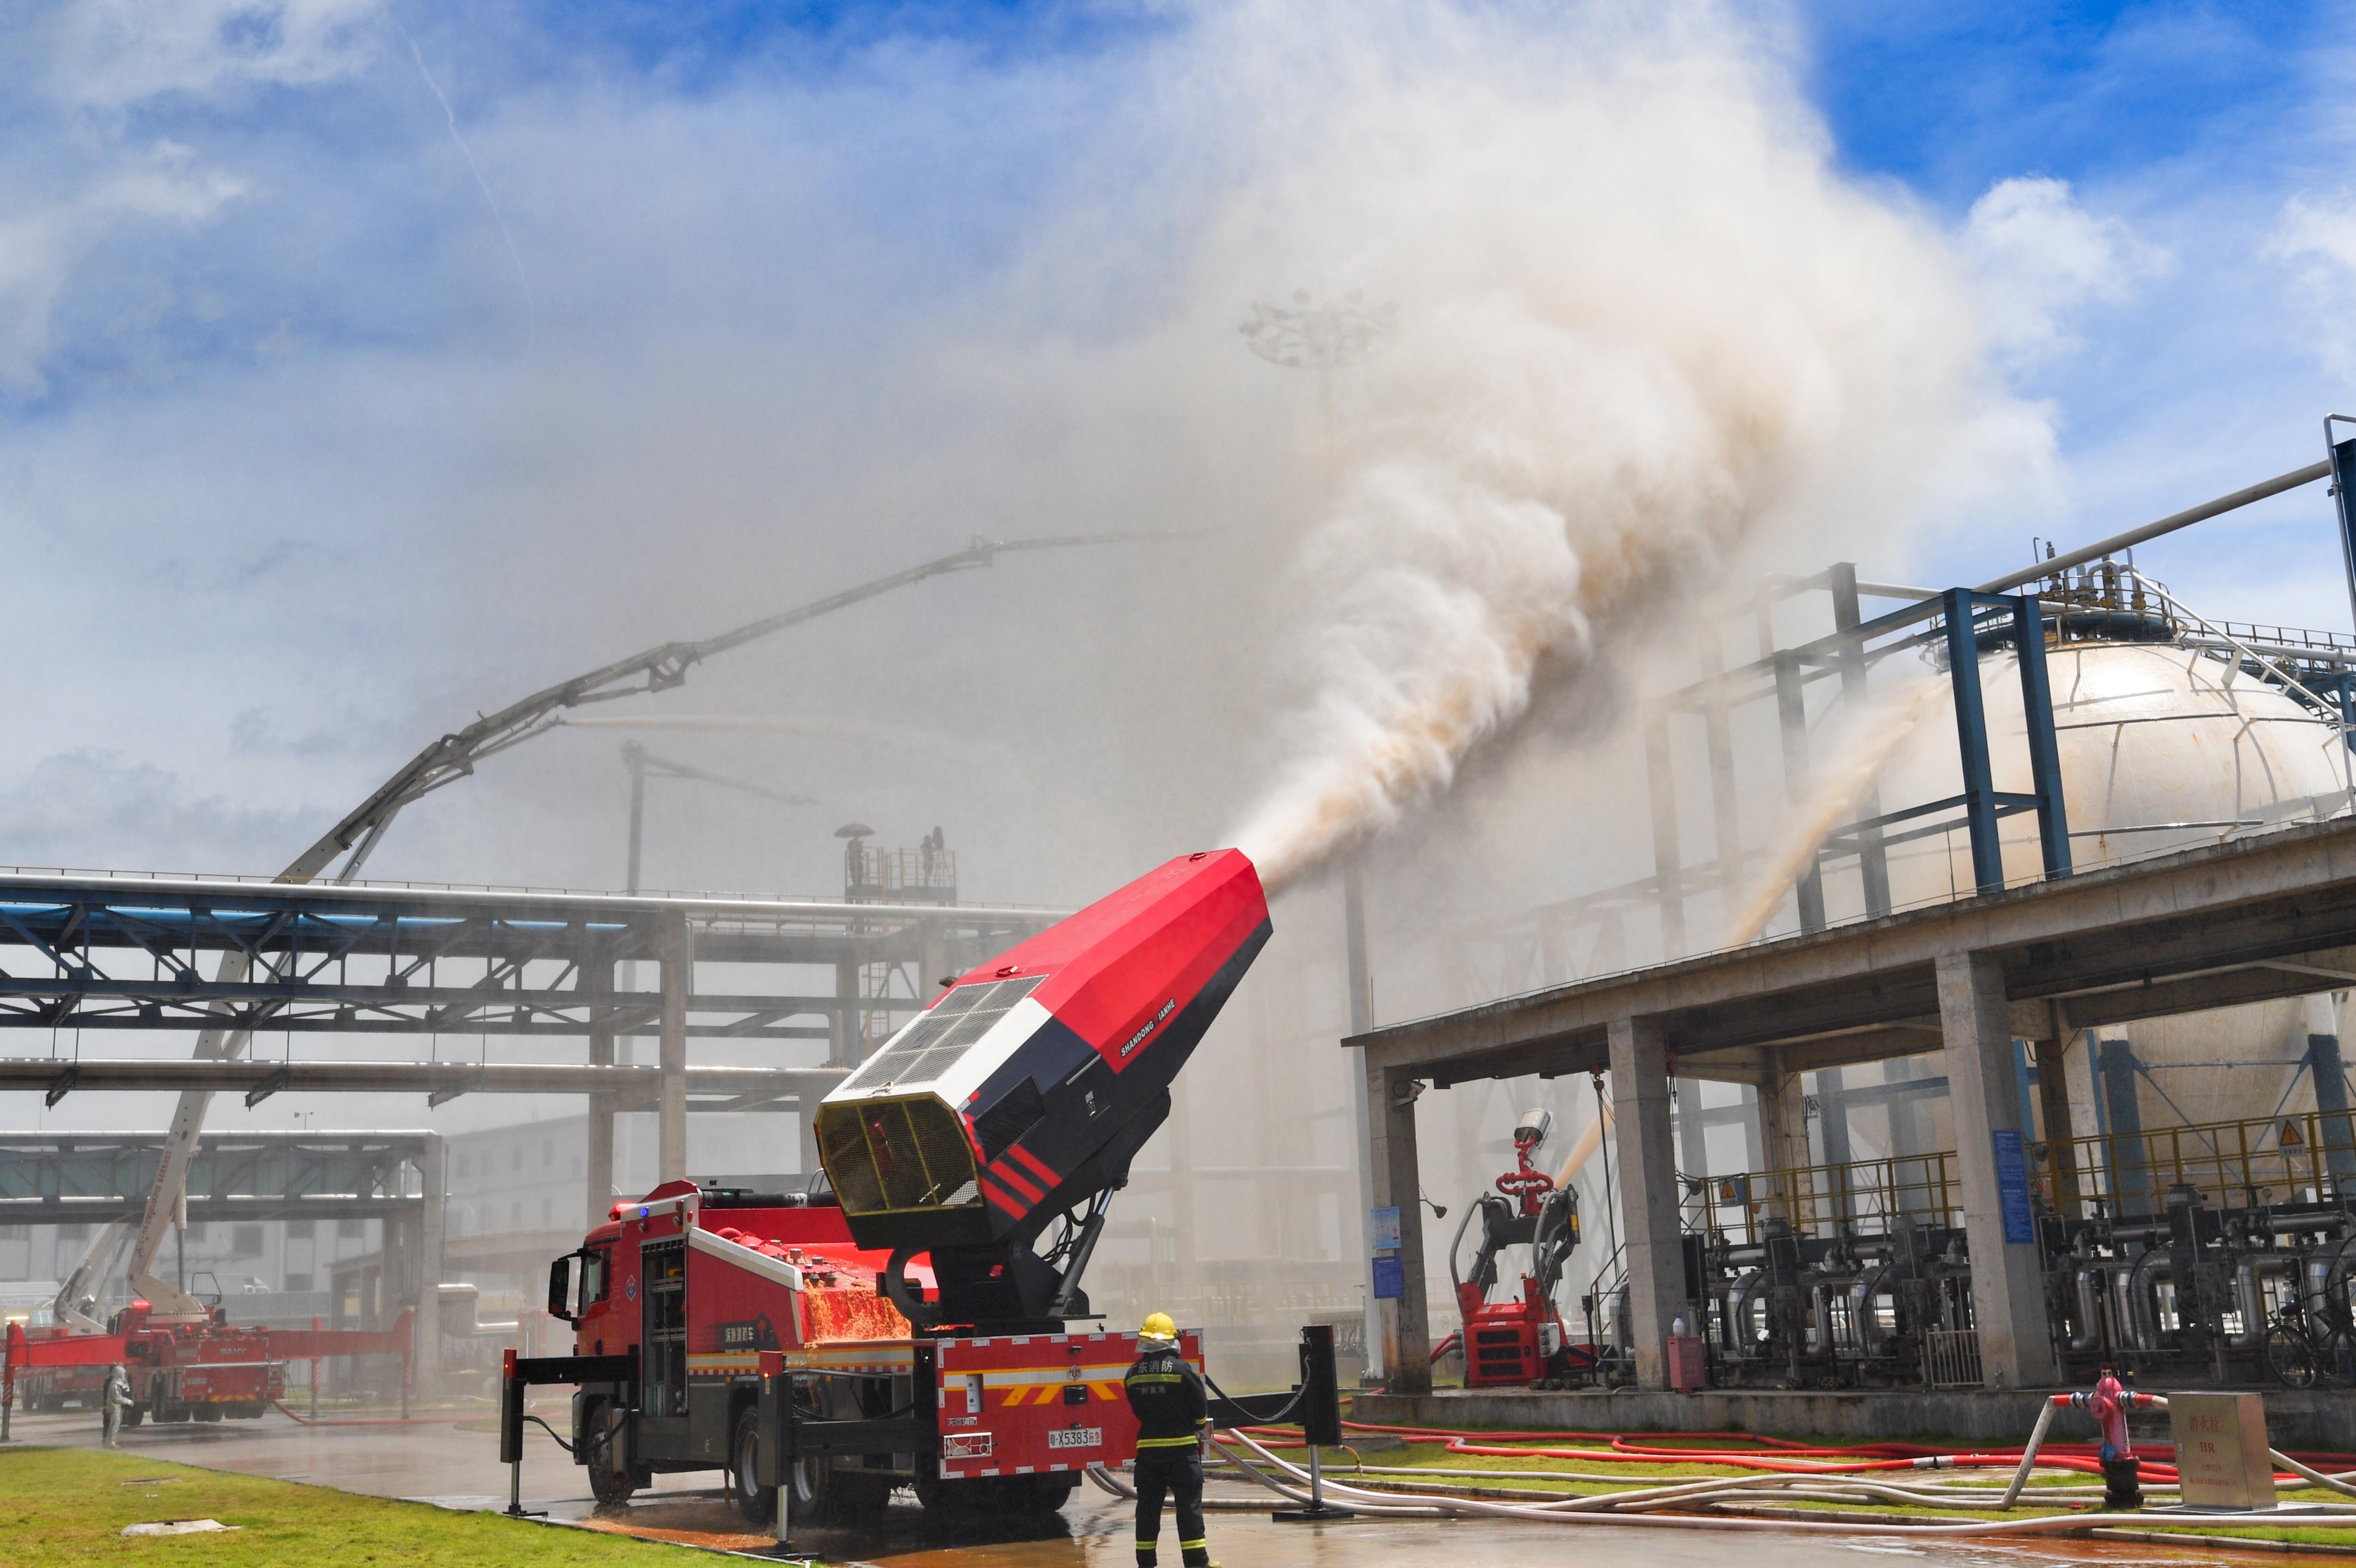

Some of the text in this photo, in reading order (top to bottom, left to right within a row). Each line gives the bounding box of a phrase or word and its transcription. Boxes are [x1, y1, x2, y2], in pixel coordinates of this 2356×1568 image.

[1121, 1021, 1154, 1057] SHANDONG
[220, 1347, 247, 1355] SANY
[2200, 1441, 2215, 1453] HR
